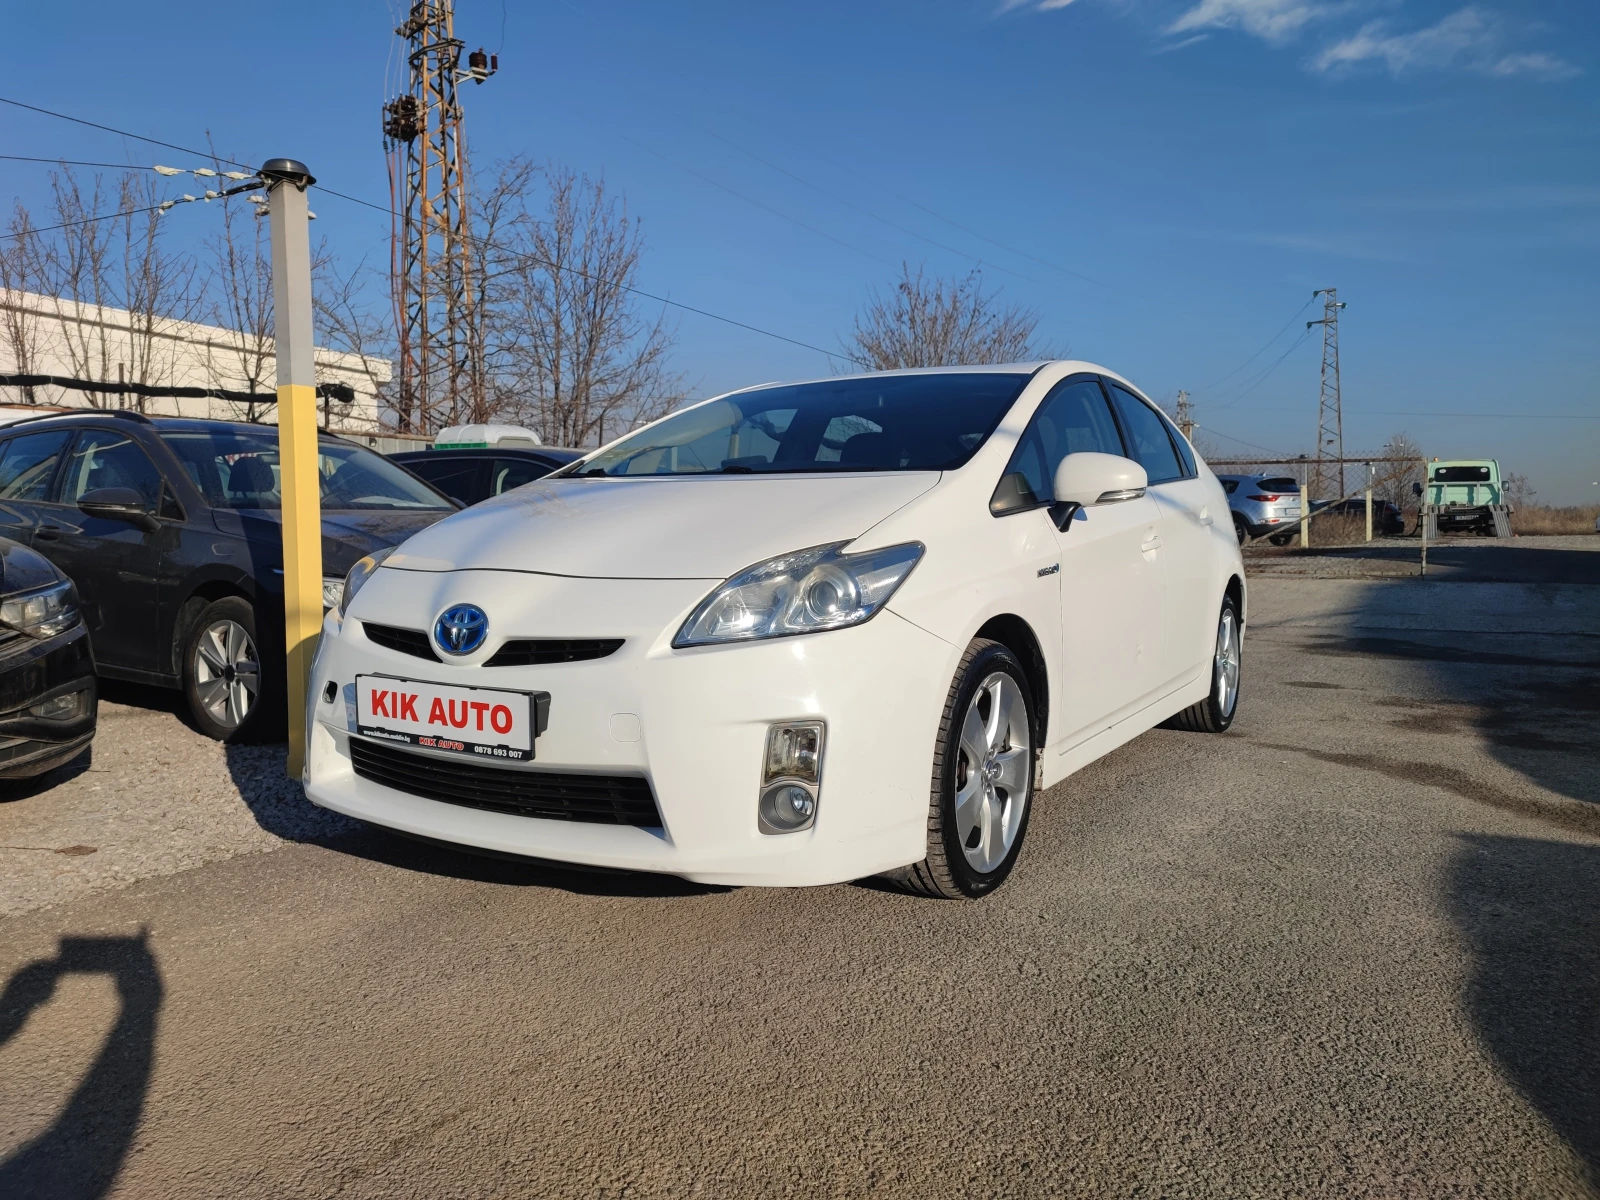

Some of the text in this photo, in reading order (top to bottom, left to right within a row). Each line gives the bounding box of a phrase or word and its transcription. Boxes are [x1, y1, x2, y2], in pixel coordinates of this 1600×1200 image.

[371, 689, 513, 734] KIK AUTO
[419, 737, 464, 750] KIK AUTO
[474, 745, 523, 759] 0878 693 007
